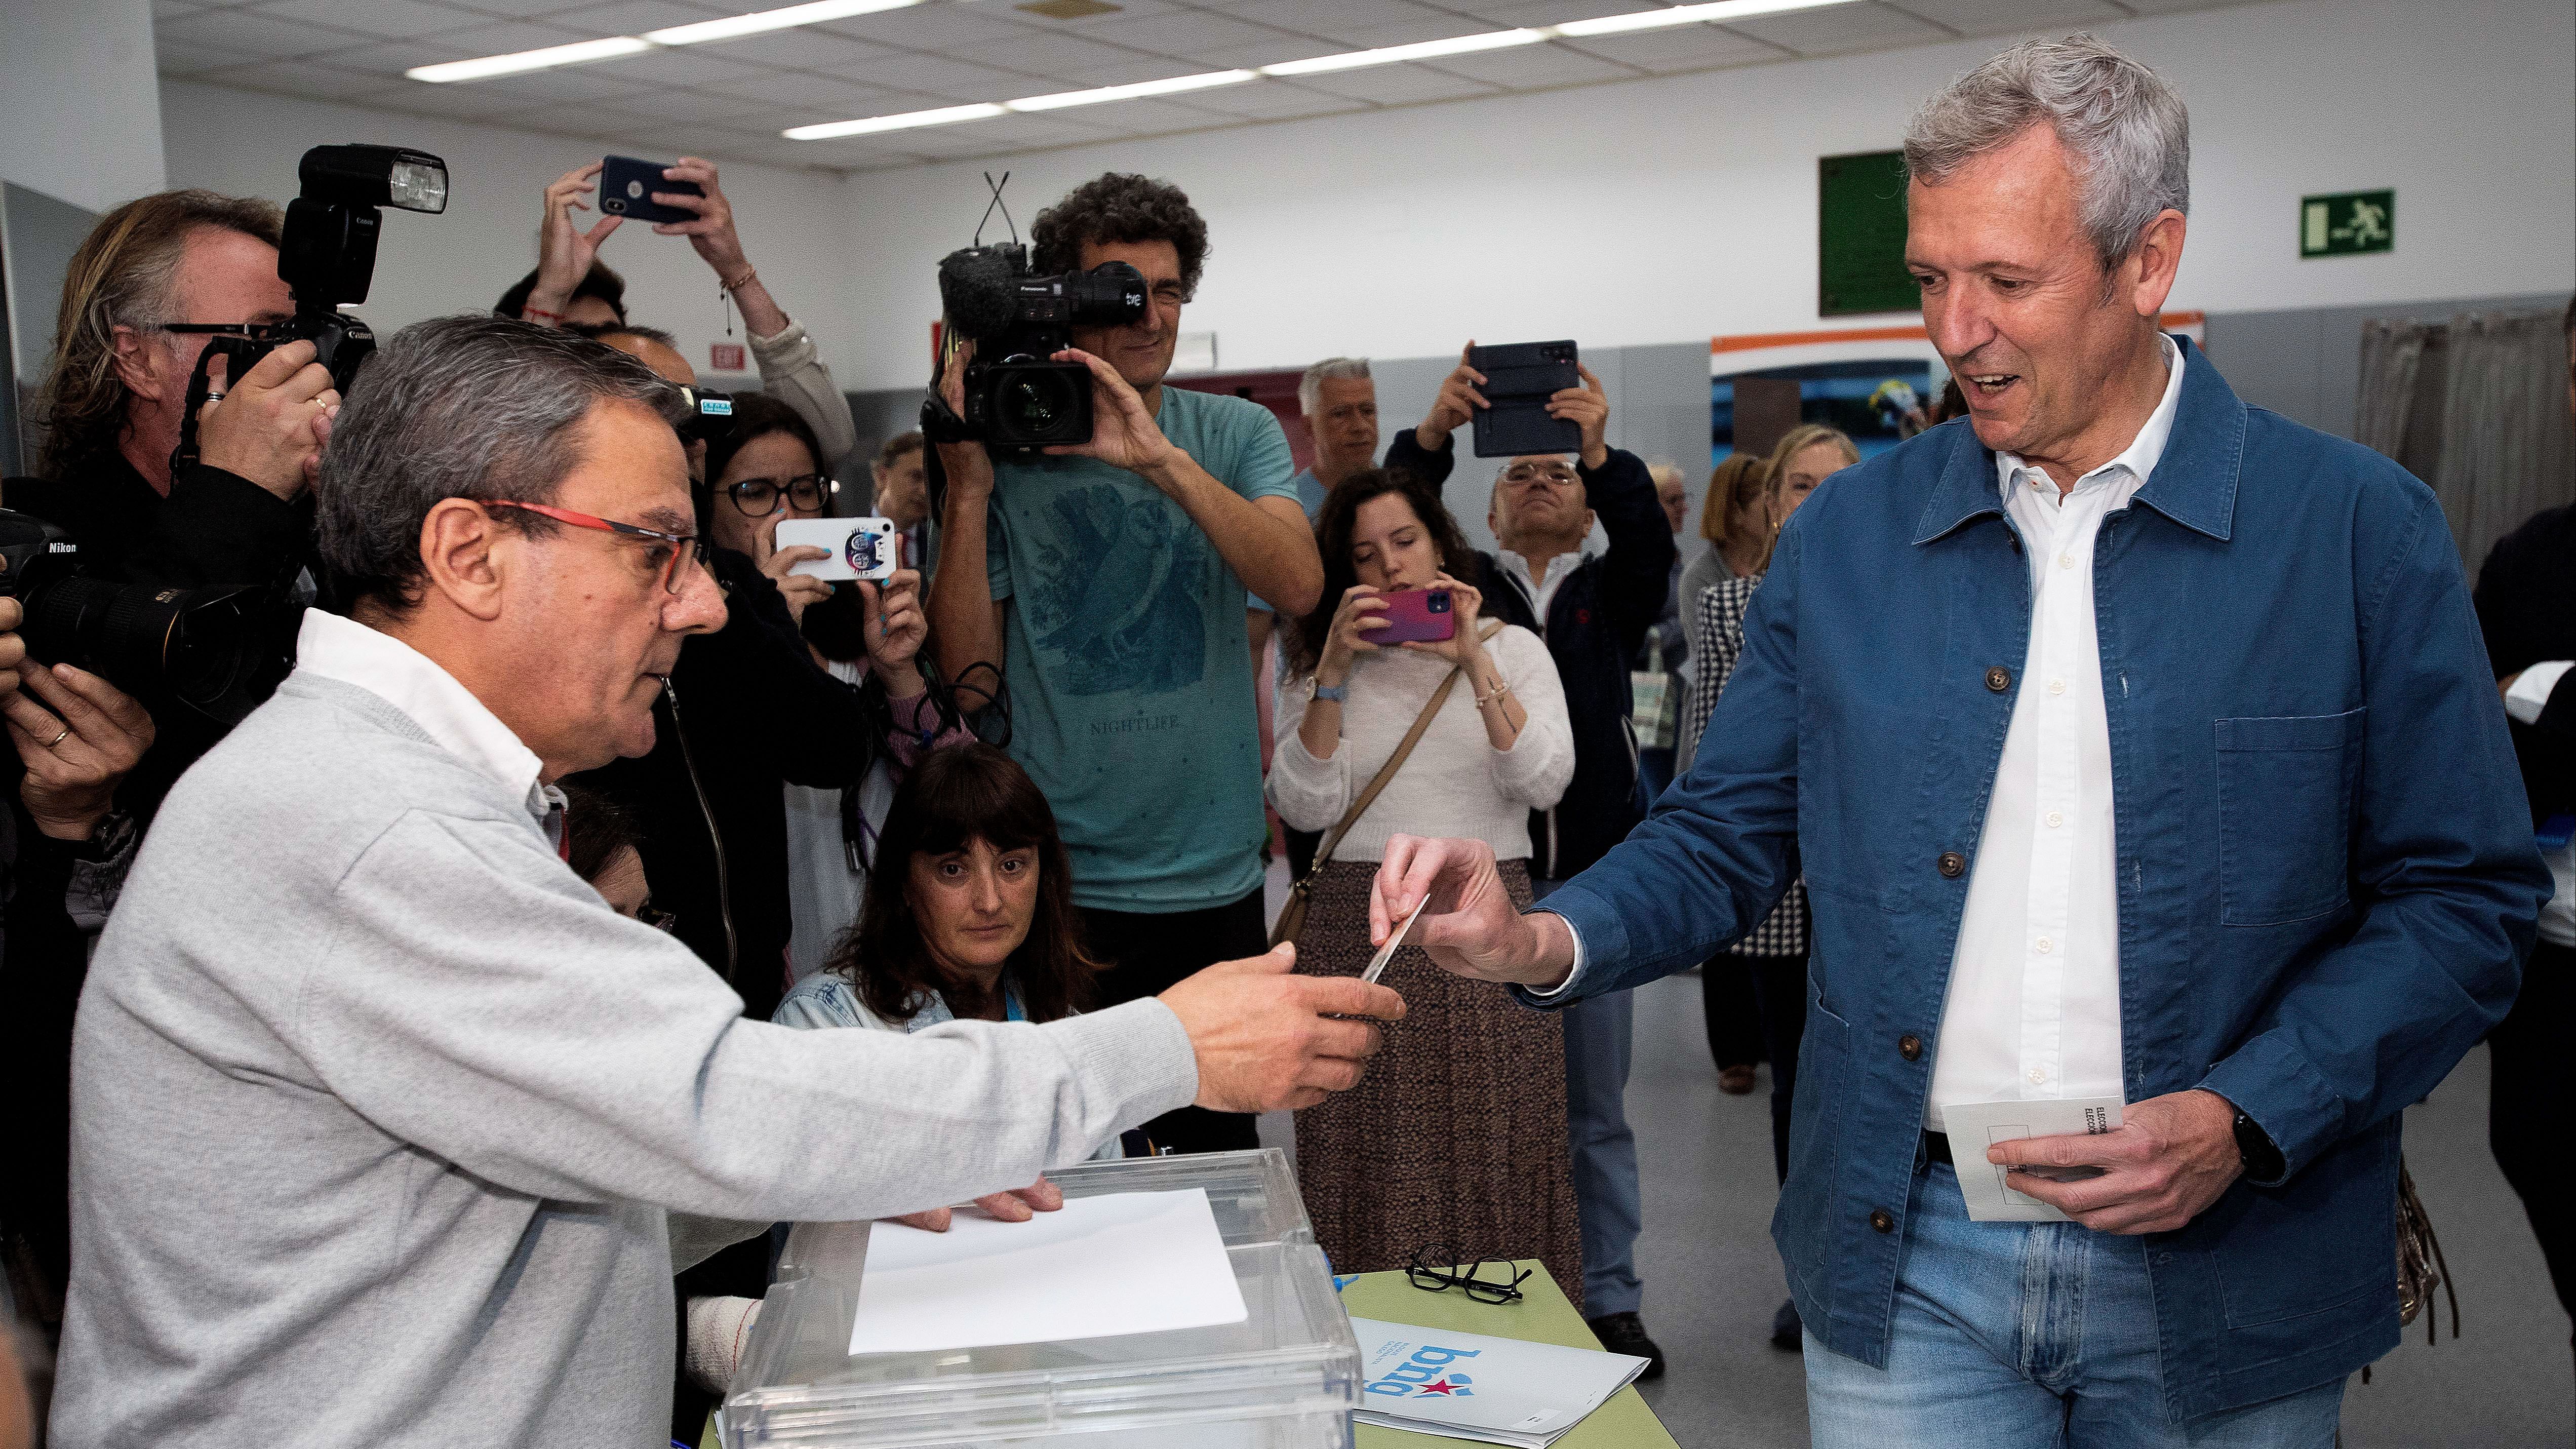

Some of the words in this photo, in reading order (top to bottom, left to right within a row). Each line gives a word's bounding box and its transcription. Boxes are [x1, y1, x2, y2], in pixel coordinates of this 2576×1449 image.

[348, 331, 373, 340] Canon
[49, 542, 76, 553] Nikon
[1090, 714, 1180, 736] NIGHTLIFE
[1363, 1345, 1482, 1397] bng
